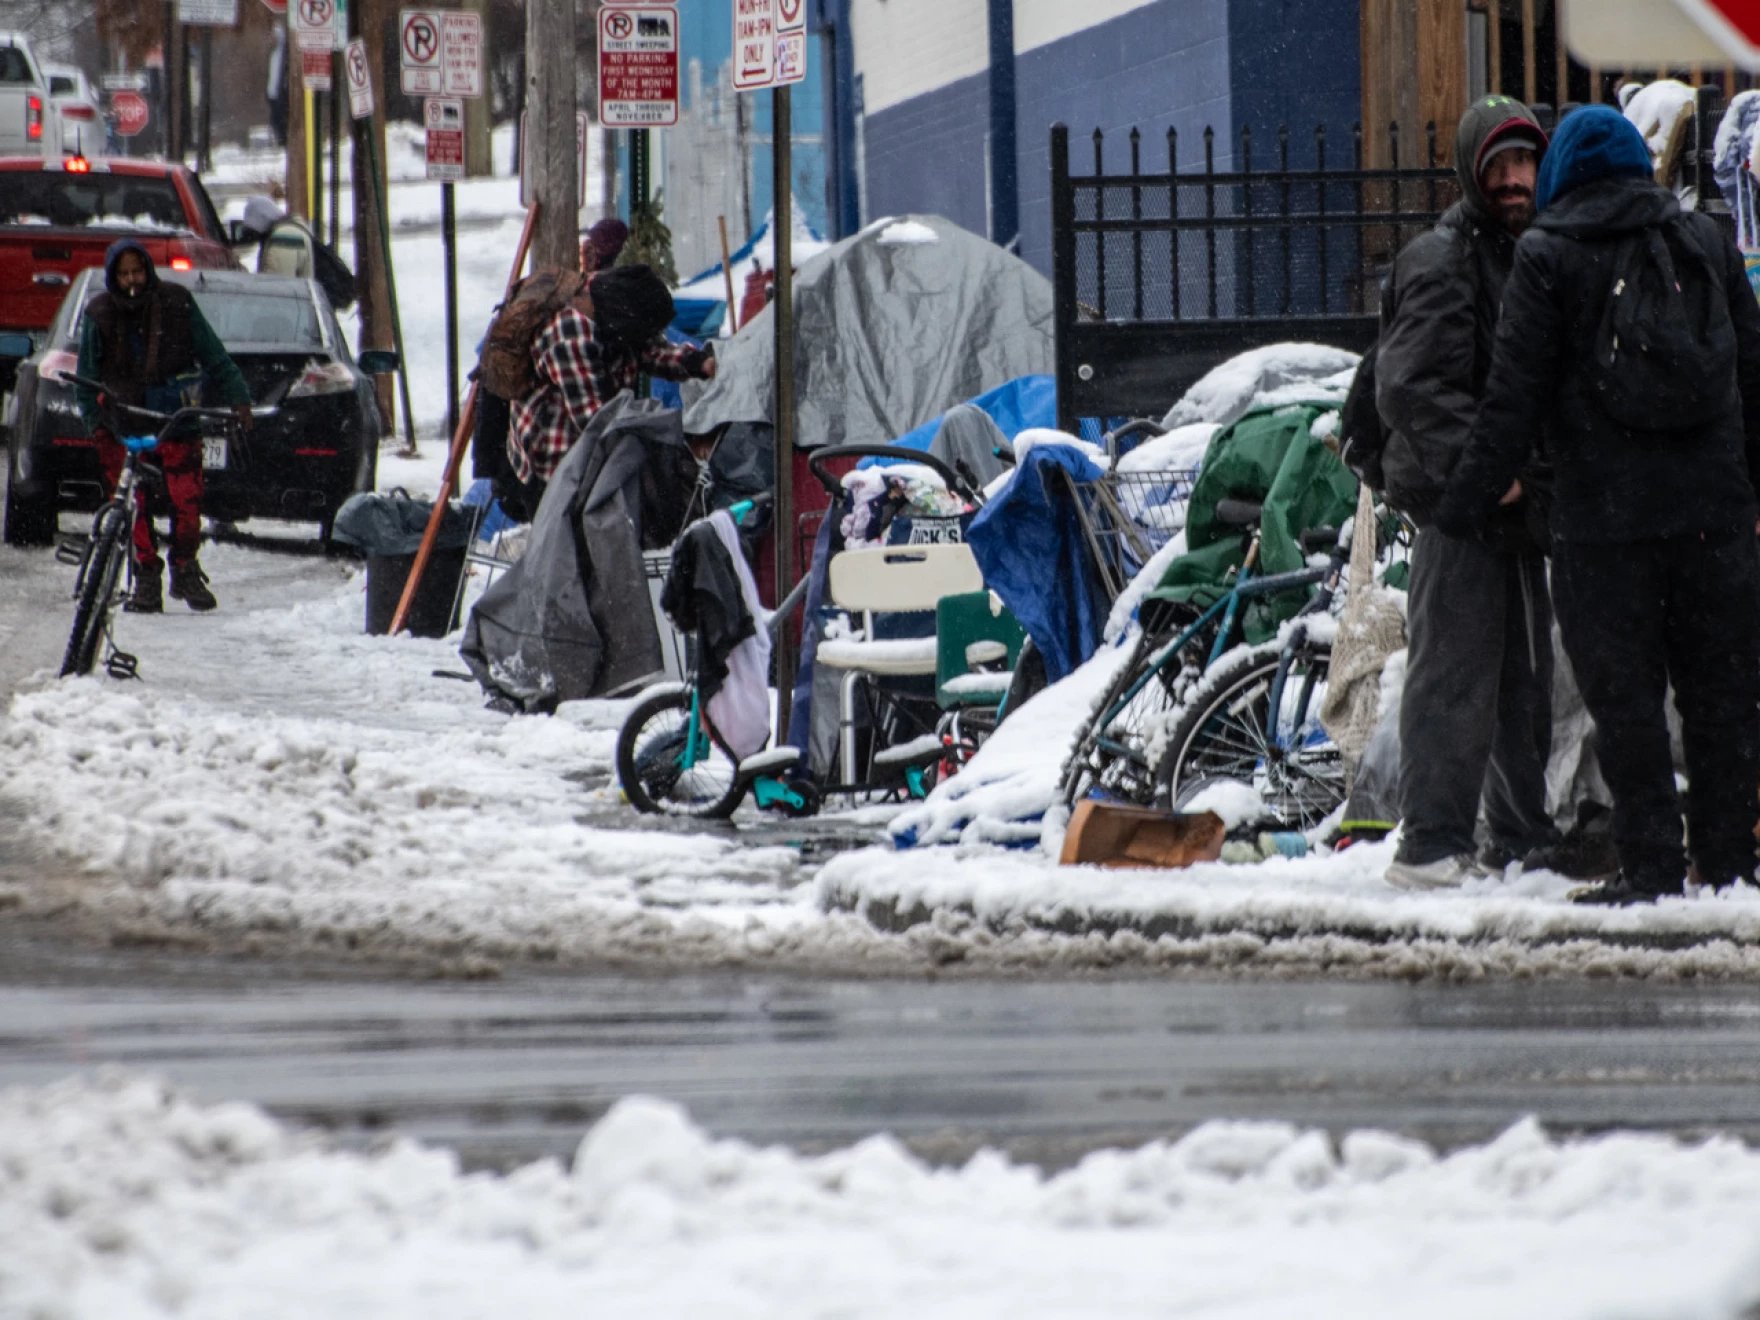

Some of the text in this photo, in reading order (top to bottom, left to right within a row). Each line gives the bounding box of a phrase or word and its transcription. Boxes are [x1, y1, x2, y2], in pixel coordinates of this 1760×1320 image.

[606, 41, 669, 49] STREET SWEEPING
[610, 54, 667, 63] NO PARKING
[743, 44, 764, 64] ONLY
[603, 66, 675, 76] FIRST WEDNESDAY
[606, 78, 672, 89] OF THE MONTH
[608, 103, 671, 112] APRIL THROUGH
[616, 113, 663, 121] NOVEMBER
